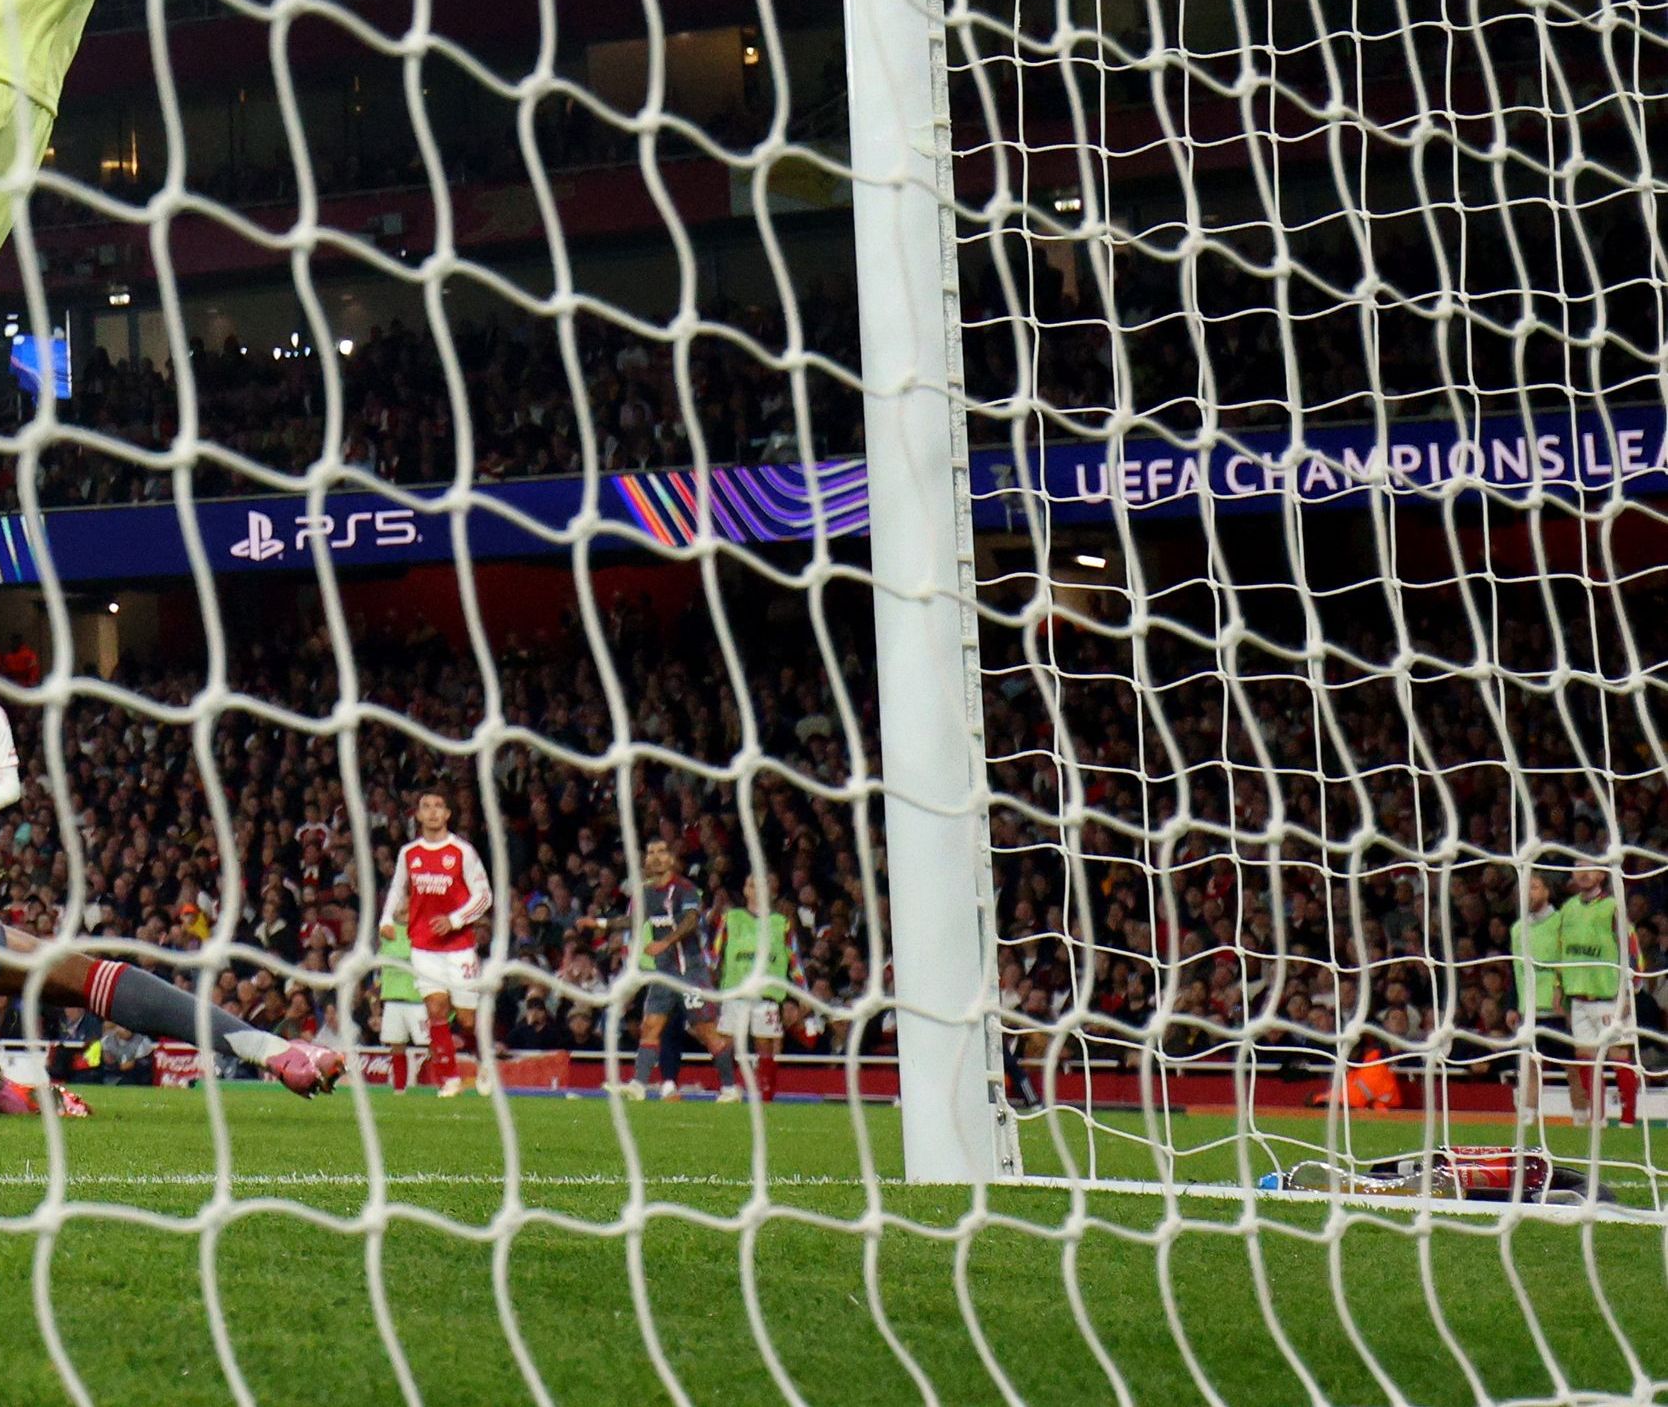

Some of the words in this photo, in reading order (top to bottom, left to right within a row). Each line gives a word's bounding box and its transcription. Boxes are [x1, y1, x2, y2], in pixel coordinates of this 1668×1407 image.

[1075, 456, 1204, 503] UEFA
[1225, 434, 1565, 495] CHAMPIONS
[295, 509, 417, 551] PS5
